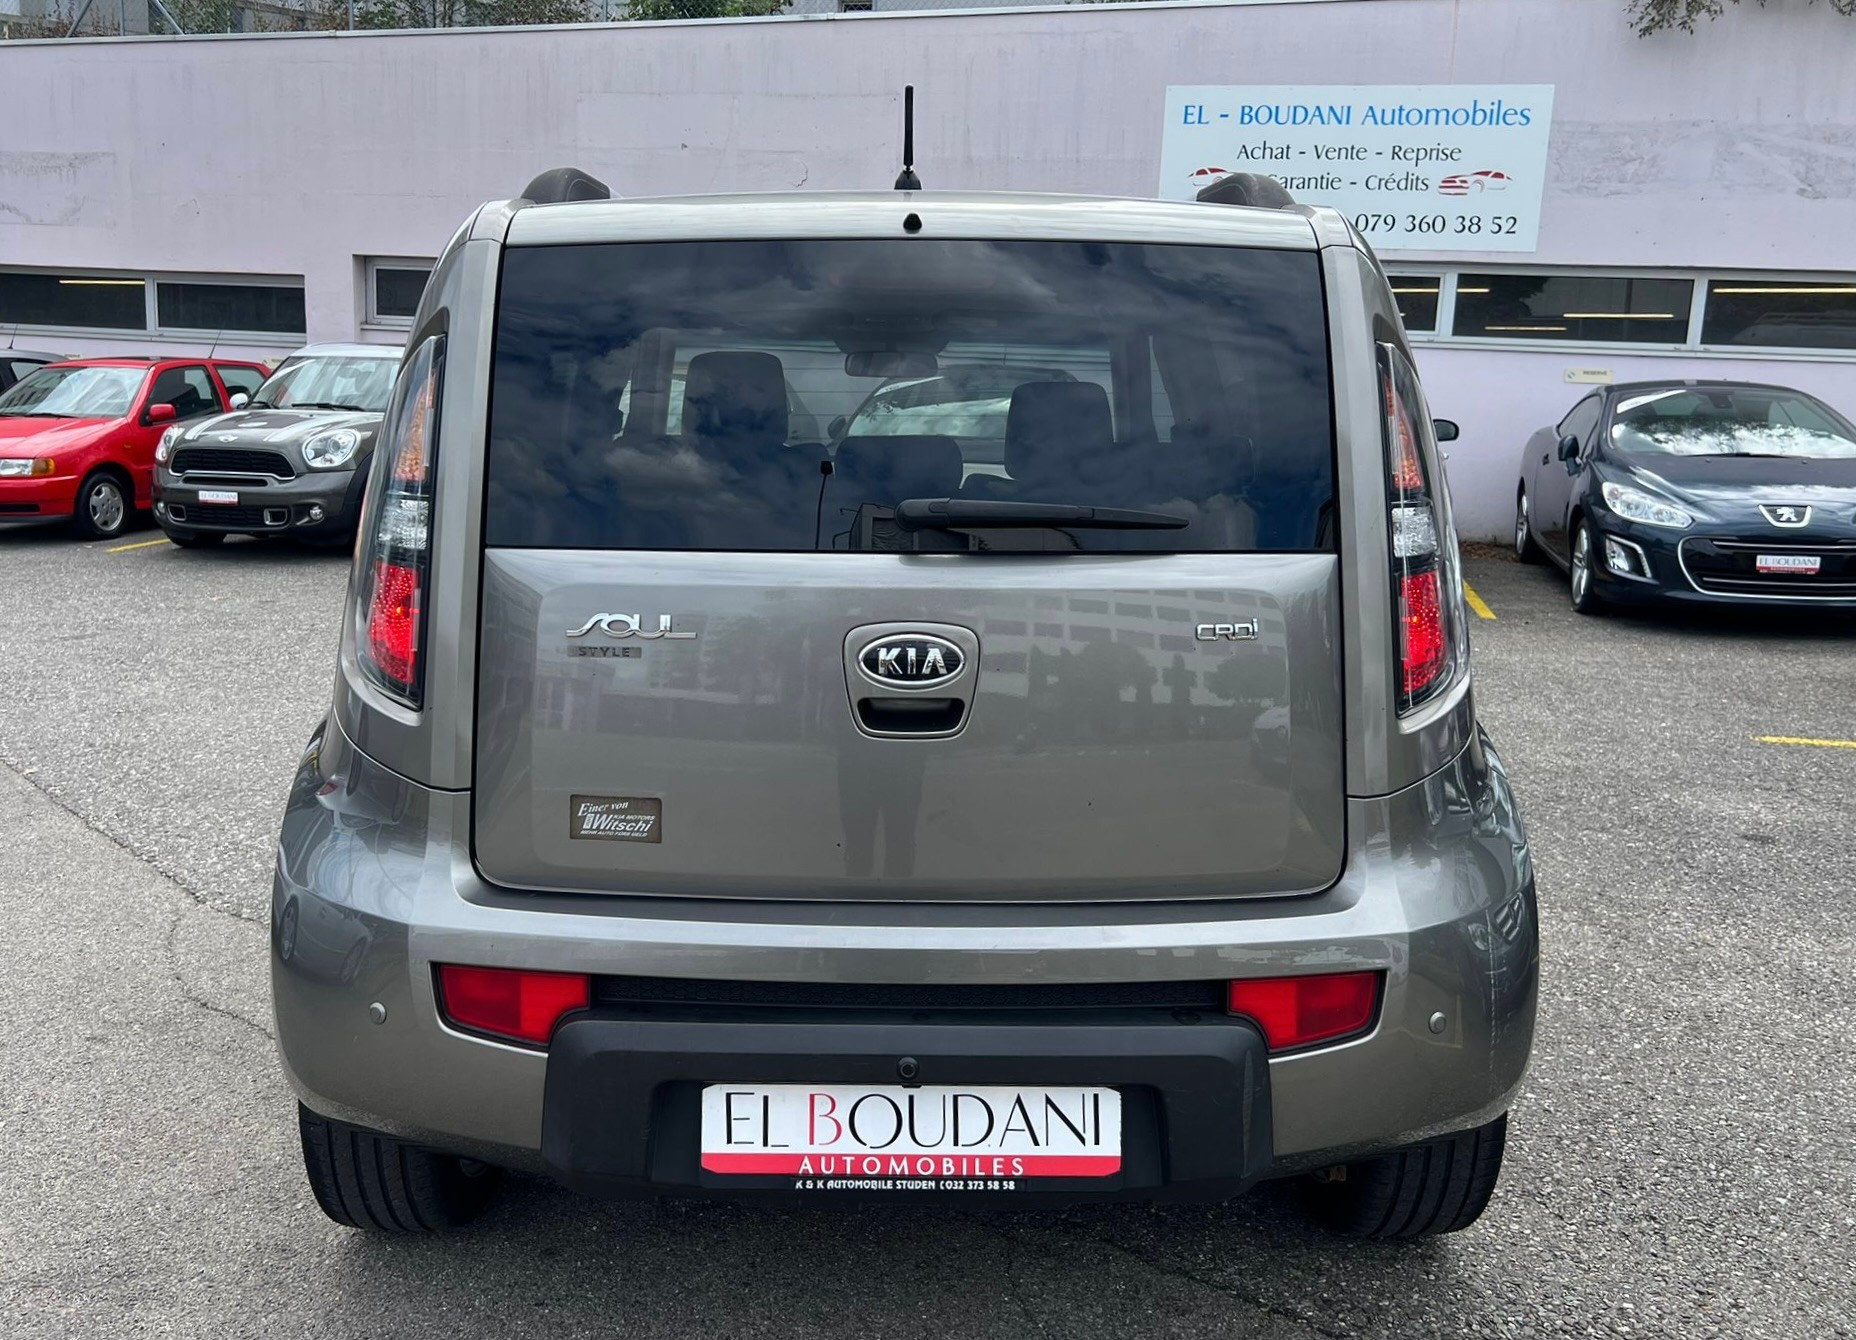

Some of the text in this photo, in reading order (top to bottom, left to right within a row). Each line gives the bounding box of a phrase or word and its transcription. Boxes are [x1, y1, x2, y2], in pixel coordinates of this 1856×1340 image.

[1182, 104, 1210, 125] EL
[1239, 104, 1352, 126] BOUDANI
[1360, 100, 1532, 127] Automobiles
[1236, 140, 1291, 161] Achat
[1313, 144, 1368, 162] Vente
[1392, 143, 1462, 167] Reprise
[1268, 173, 1342, 191] arantie
[1365, 173, 1430, 192] Crédits
[1355, 213, 1518, 235] 079 360 38 52
[565, 612, 697, 639] SOUL
[578, 646, 631, 658] STYLE
[877, 647, 948, 675] KIA
[578, 802, 629, 816] Einer von
[592, 813, 653, 832] Witschi
[725, 1092, 1100, 1148] EL BOUDANI
[798, 1155, 1024, 1175] AUTOMOBILES
[795, 1180, 803, 1189] K
[805, 1180, 814, 1189] &
[816, 1180, 824, 1189] K
[827, 1180, 893, 1190] AUTOMOBILE
[895, 1180, 935, 1190] STUDEN
[967, 1181, 984, 1190] 373
[987, 1181, 999, 1190] 58
[1003, 1181, 1015, 1190] 58
